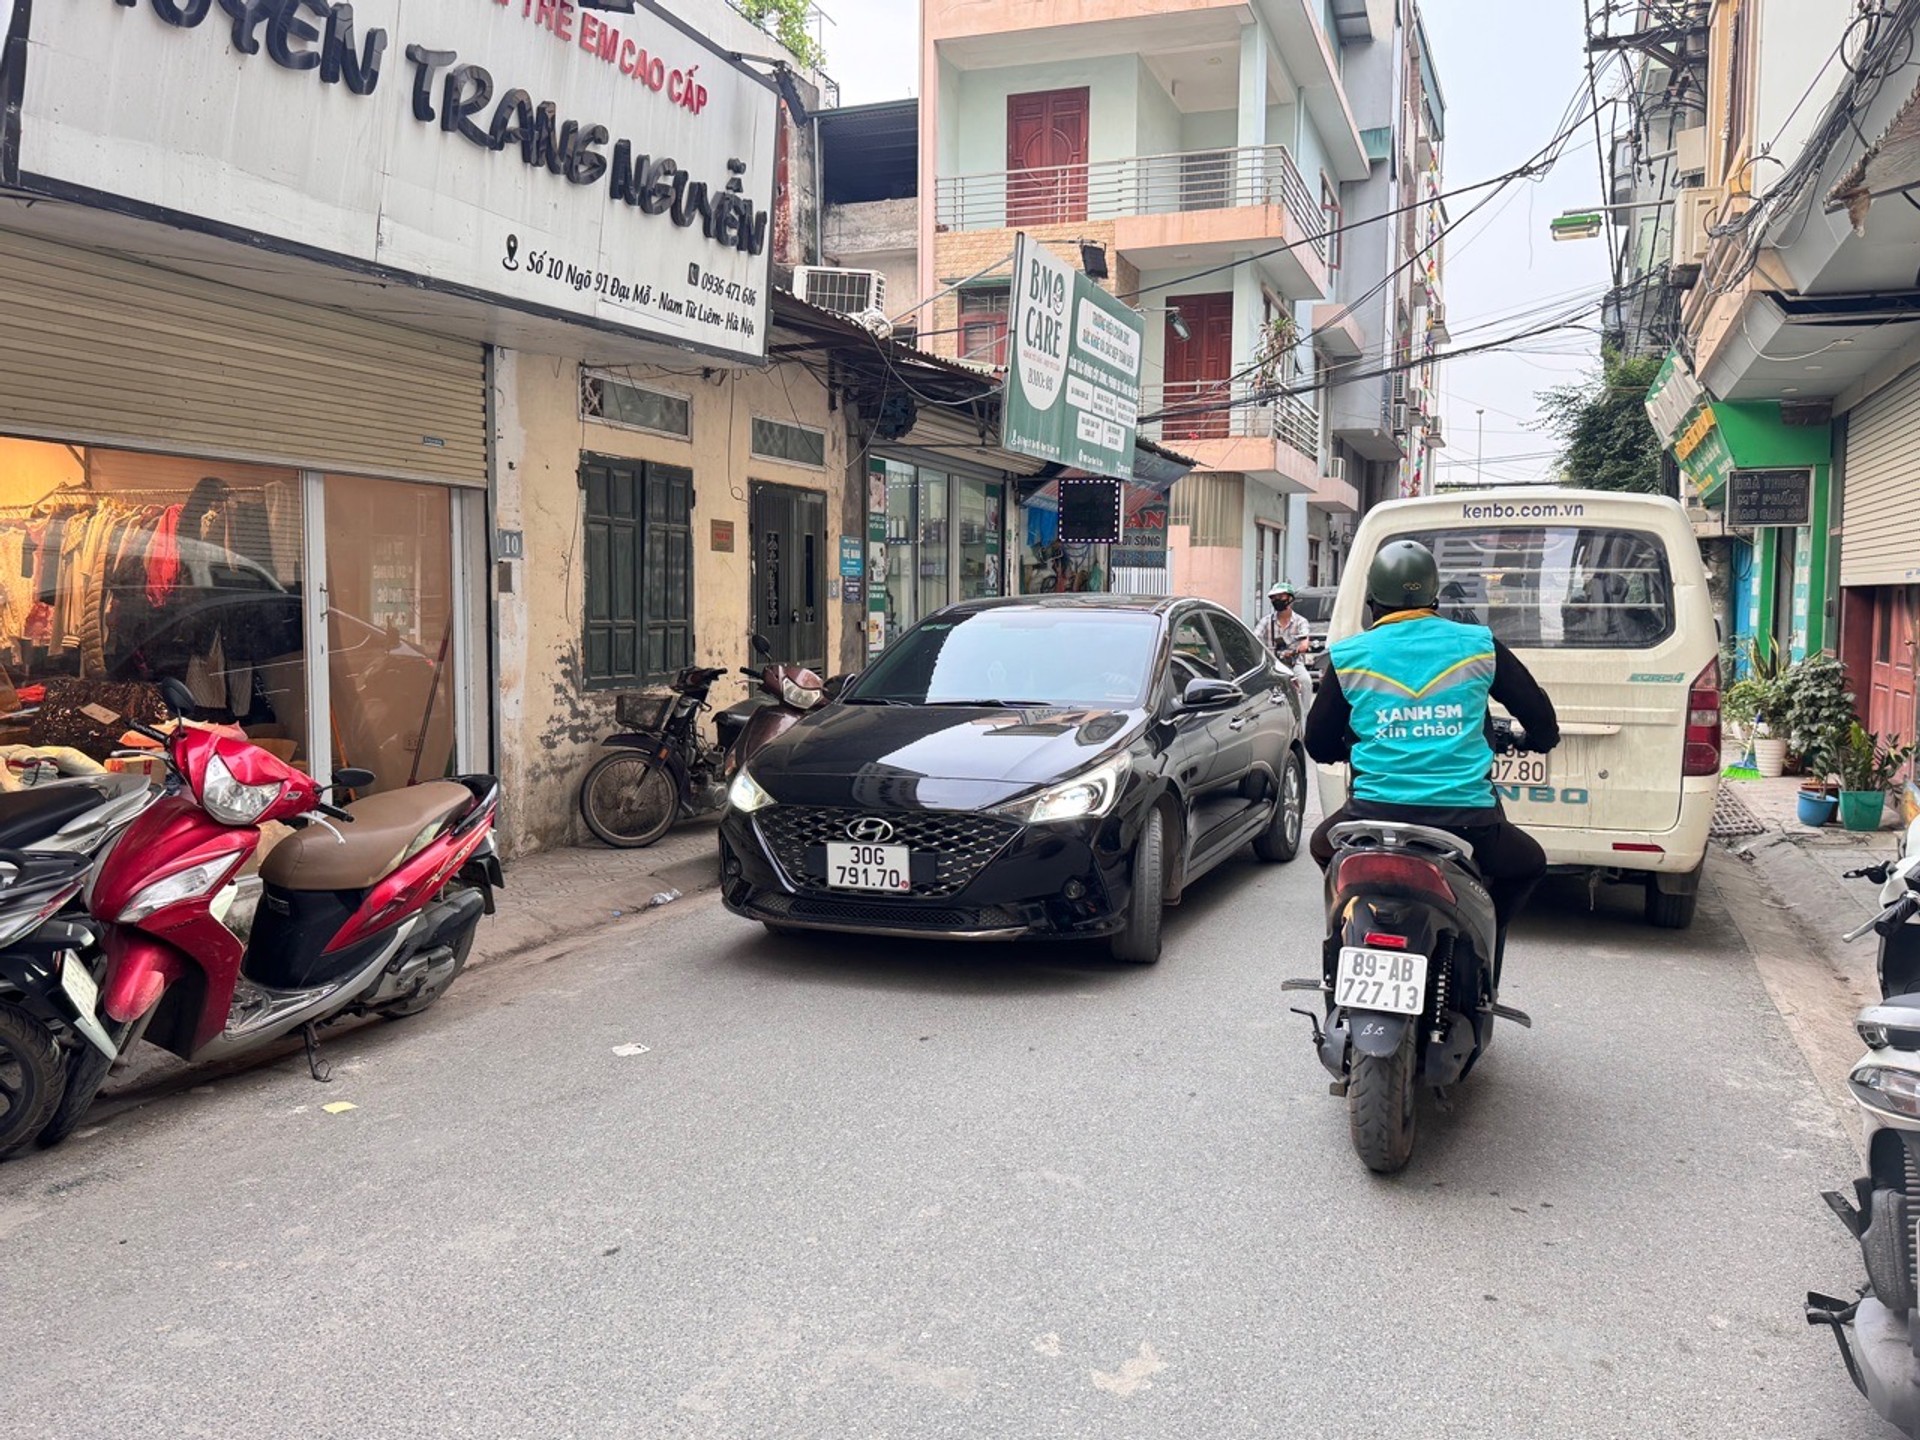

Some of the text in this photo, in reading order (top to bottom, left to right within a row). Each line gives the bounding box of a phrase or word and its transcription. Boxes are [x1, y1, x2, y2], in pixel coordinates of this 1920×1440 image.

[579, 12, 619, 64] EM
[618, 38, 666, 93] CAO
[667, 64, 709, 116] CẤP
[405, 43, 609, 186] TRANG
[526, 250, 548, 274] Số
[546, 257, 564, 281] 10
[565, 263, 592, 291] Ngõ
[594, 272, 609, 294] 91
[658, 291, 683, 316] Nam
[685, 299, 697, 319] Từ
[725, 312, 740, 332] Hà
[701, 271, 725, 297] 0936
[725, 281, 741, 302] 471
[1025, 305, 1063, 360] CARE
[1462, 503, 1584, 519] kenbo.com.vn
[504, 536, 520, 554] 10
[1374, 721, 1463, 739] xin chào!
[1490, 759, 1545, 783] 07.80
[850, 846, 885, 866] 30G
[836, 866, 901, 888] 791.70
[1351, 952, 1414, 983] 89-AB
[1341, 978, 1419, 1010] 727.13
